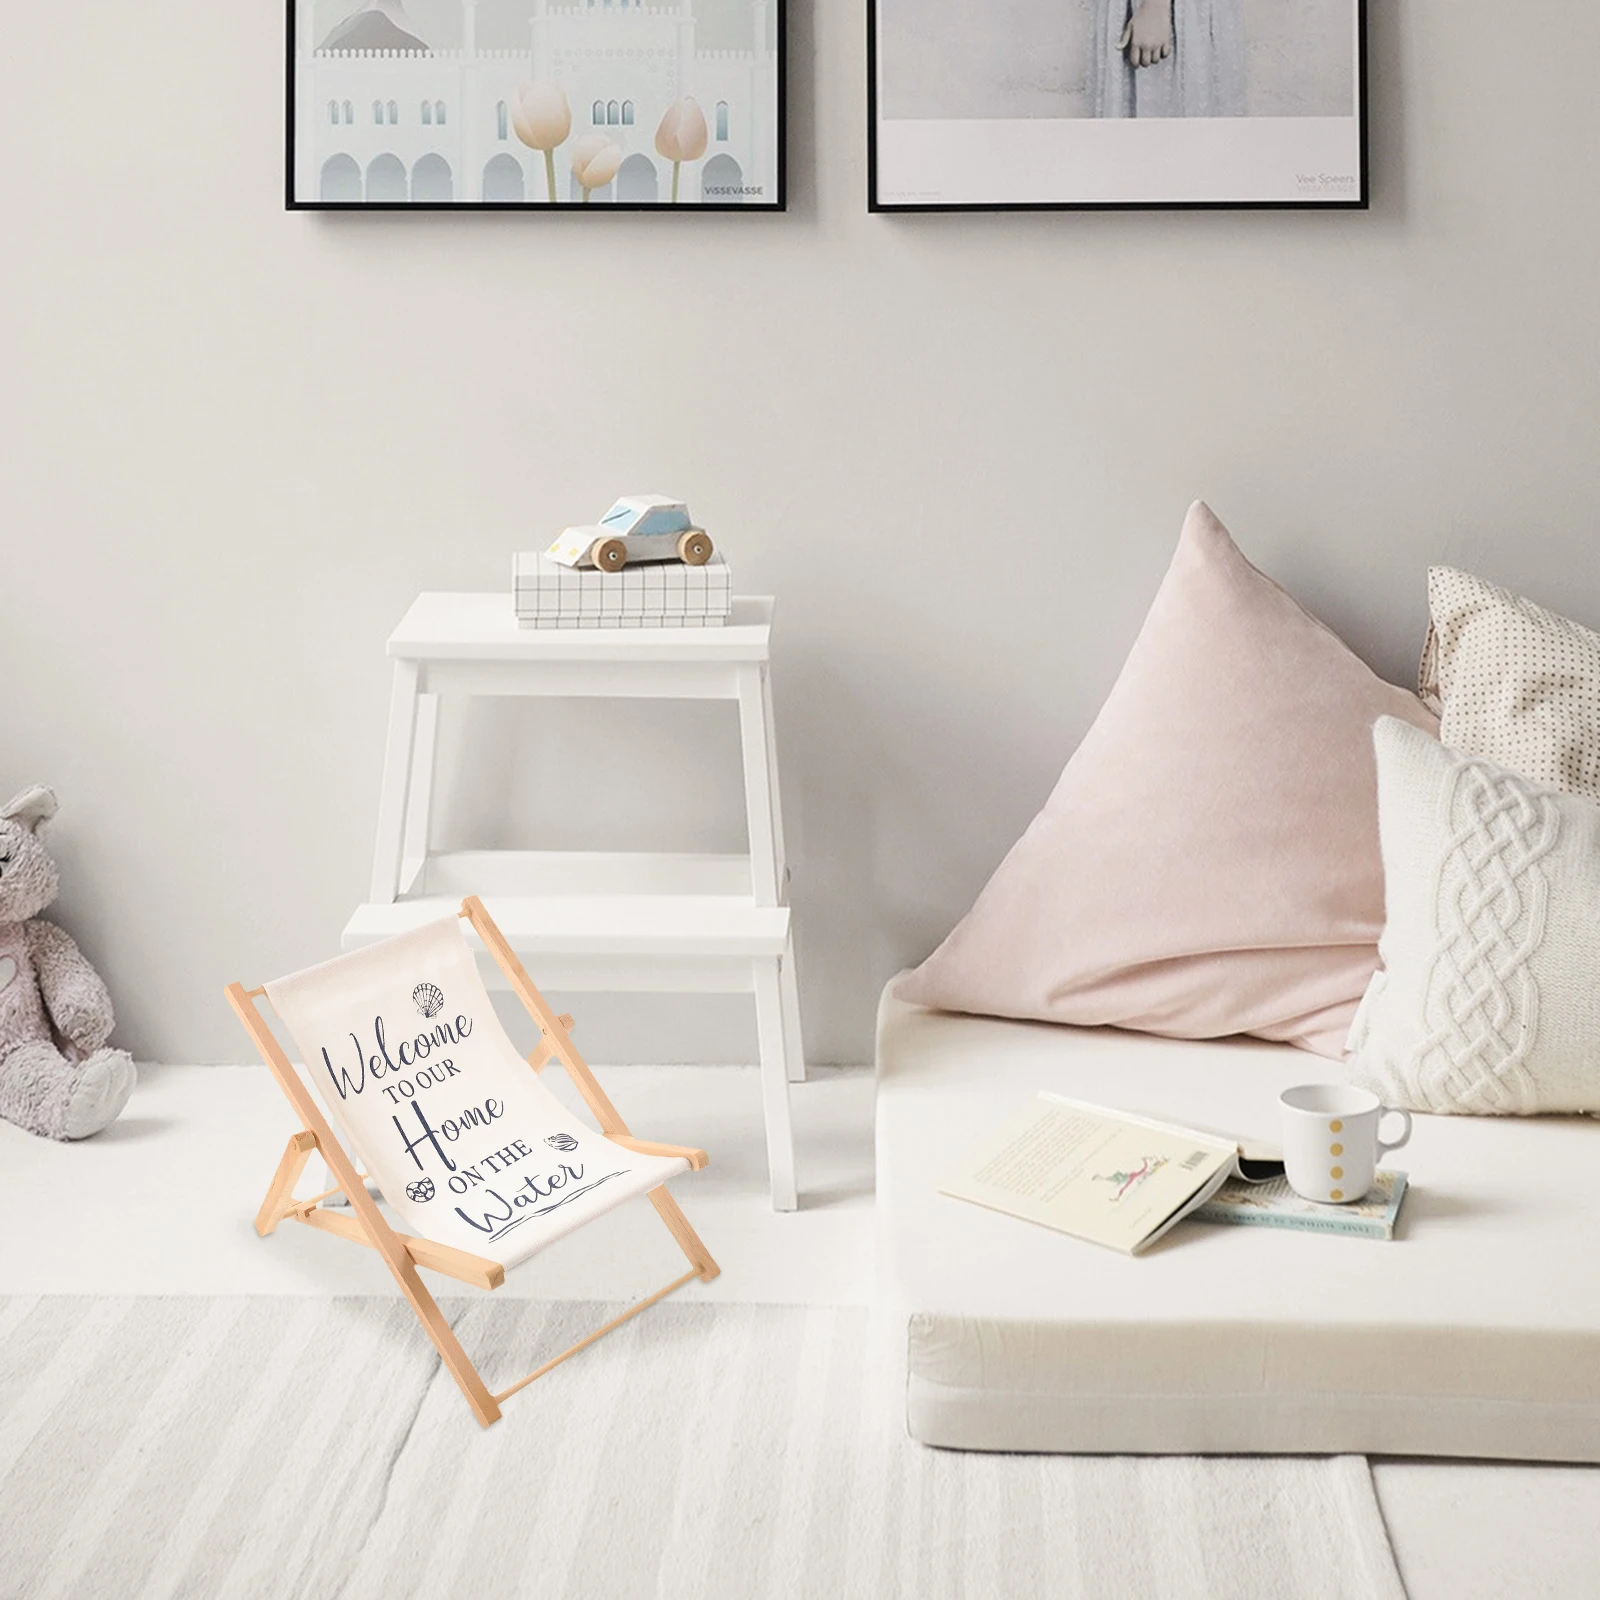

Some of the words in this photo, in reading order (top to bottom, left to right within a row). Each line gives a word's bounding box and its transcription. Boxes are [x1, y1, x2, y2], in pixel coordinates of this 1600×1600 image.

[1295, 173, 1316, 184] Vee
[321, 1014, 473, 1101] Welcome
[382, 1079, 415, 1104] TO
[415, 1058, 461, 1090] OUR
[392, 1097, 504, 1172] Home
[448, 1166, 485, 1194] ON
[480, 1139, 533, 1174] THE
[454, 1163, 584, 1234] Water
